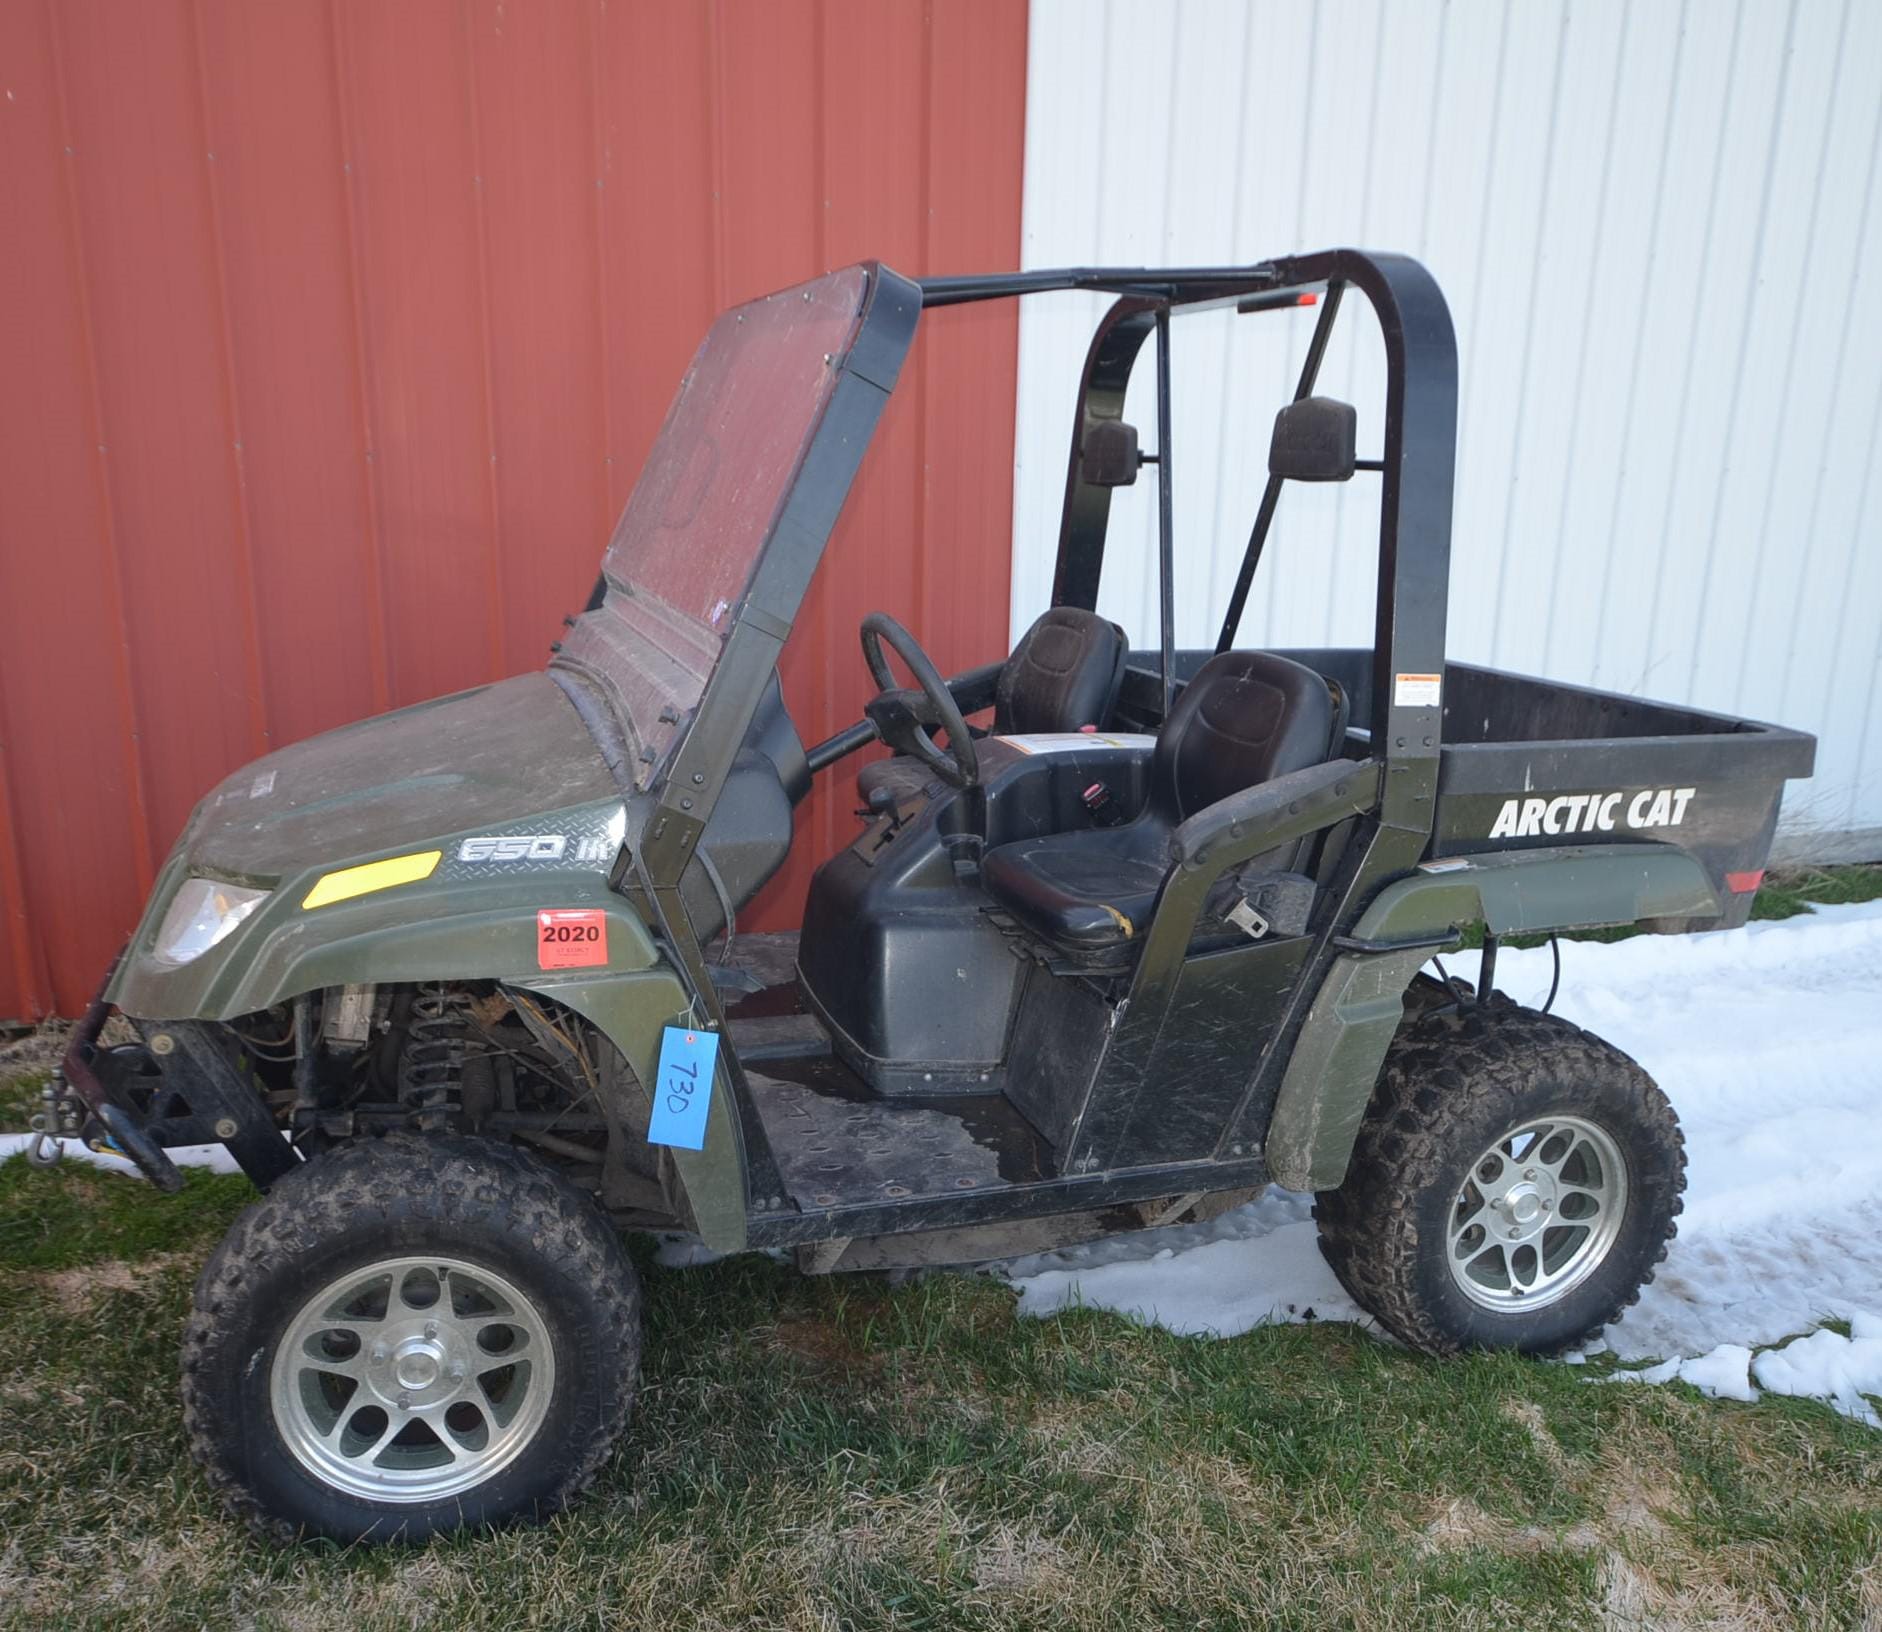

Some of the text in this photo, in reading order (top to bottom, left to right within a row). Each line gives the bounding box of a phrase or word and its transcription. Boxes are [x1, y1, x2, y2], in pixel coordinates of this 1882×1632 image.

[1488, 788, 1697, 838] ARCTIC CAT
[458, 835, 567, 863] 650
[543, 926, 600, 943] 2020
[667, 1062, 698, 1114] 730
